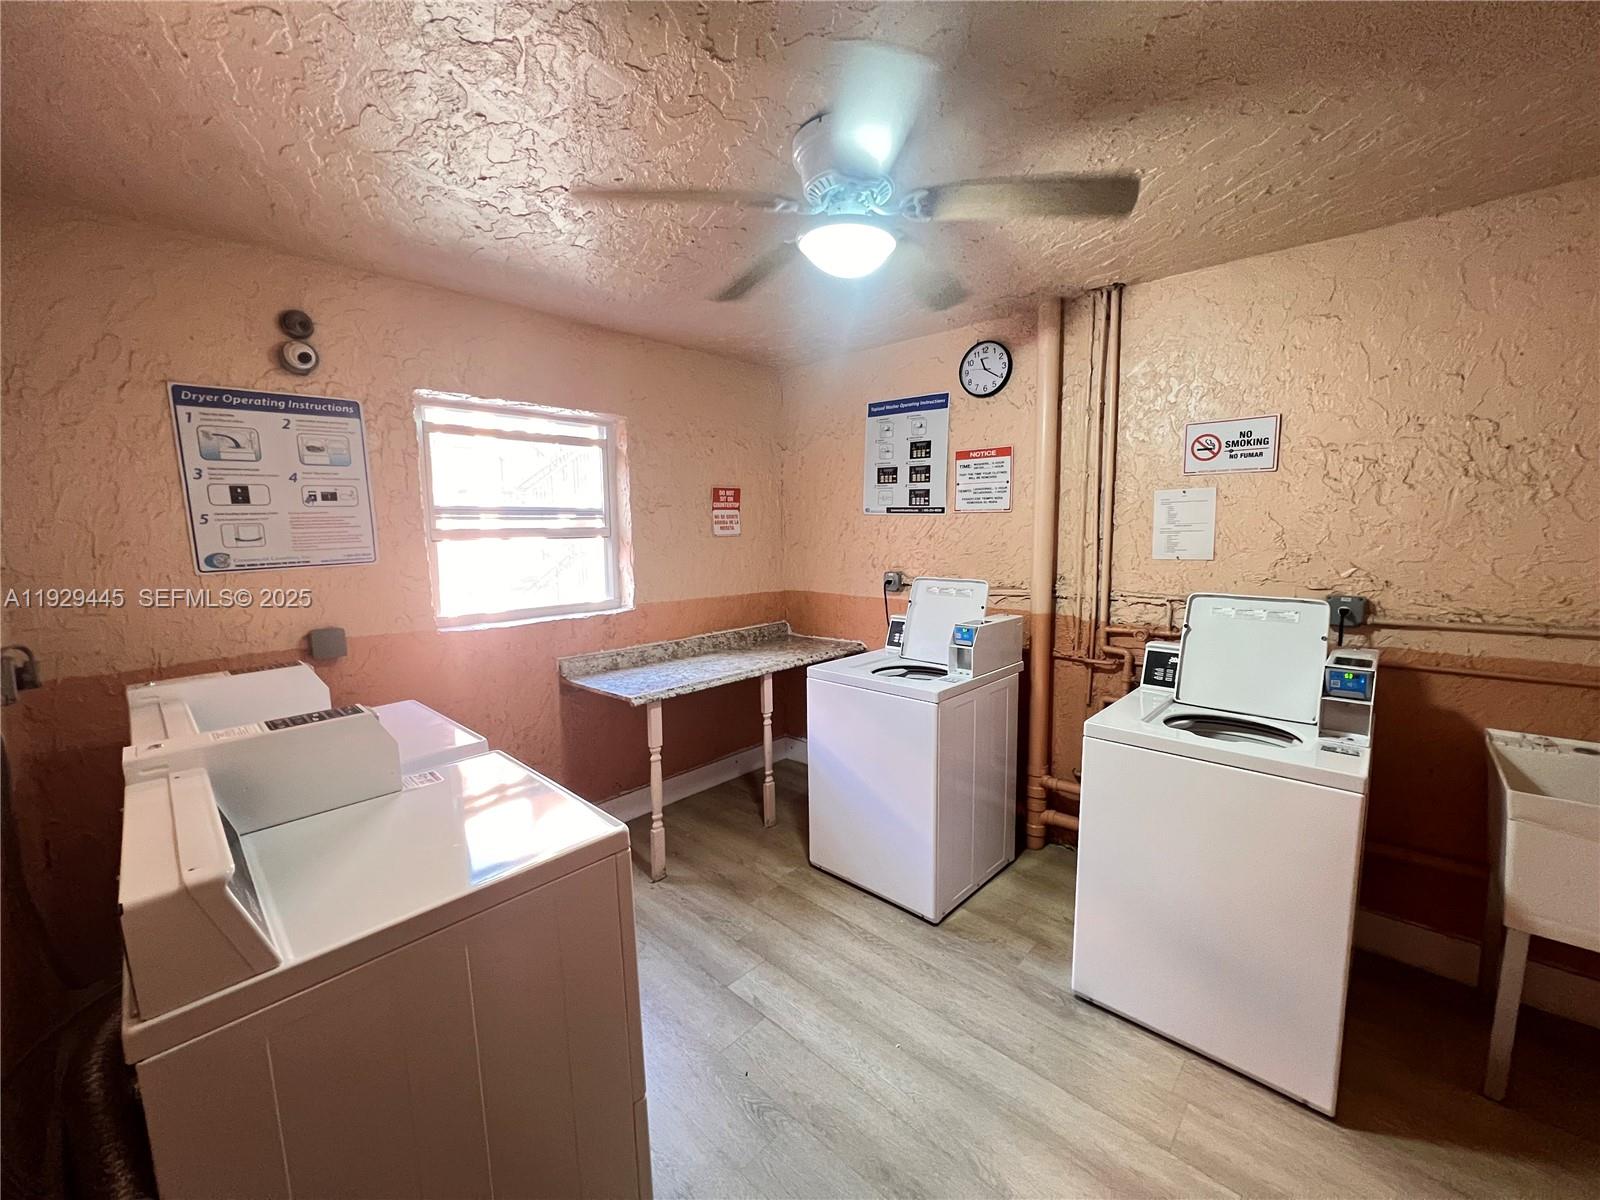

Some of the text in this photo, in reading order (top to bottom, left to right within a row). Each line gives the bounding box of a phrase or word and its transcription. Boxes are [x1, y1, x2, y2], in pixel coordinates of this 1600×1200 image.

[982, 346, 989, 354] 12
[998, 352, 1004, 360] 2
[967, 359, 974, 367] 10
[1001, 361, 1007, 369] 3
[967, 378, 973, 386] 8
[992, 380, 997, 388] 5
[180, 390, 355, 414] Dryer Operating Instructions
[184, 411, 192, 423] 1
[282, 418, 291, 429] 2
[1239, 430, 1253, 438] NO
[1224, 437, 1270, 448] SMOKING
[969, 449, 997, 458] NOTICE
[1239, 451, 1264, 459] FUMAR
[193, 468, 204, 480] 3
[288, 472, 298, 483] 4
[199, 513, 209, 525] 5
